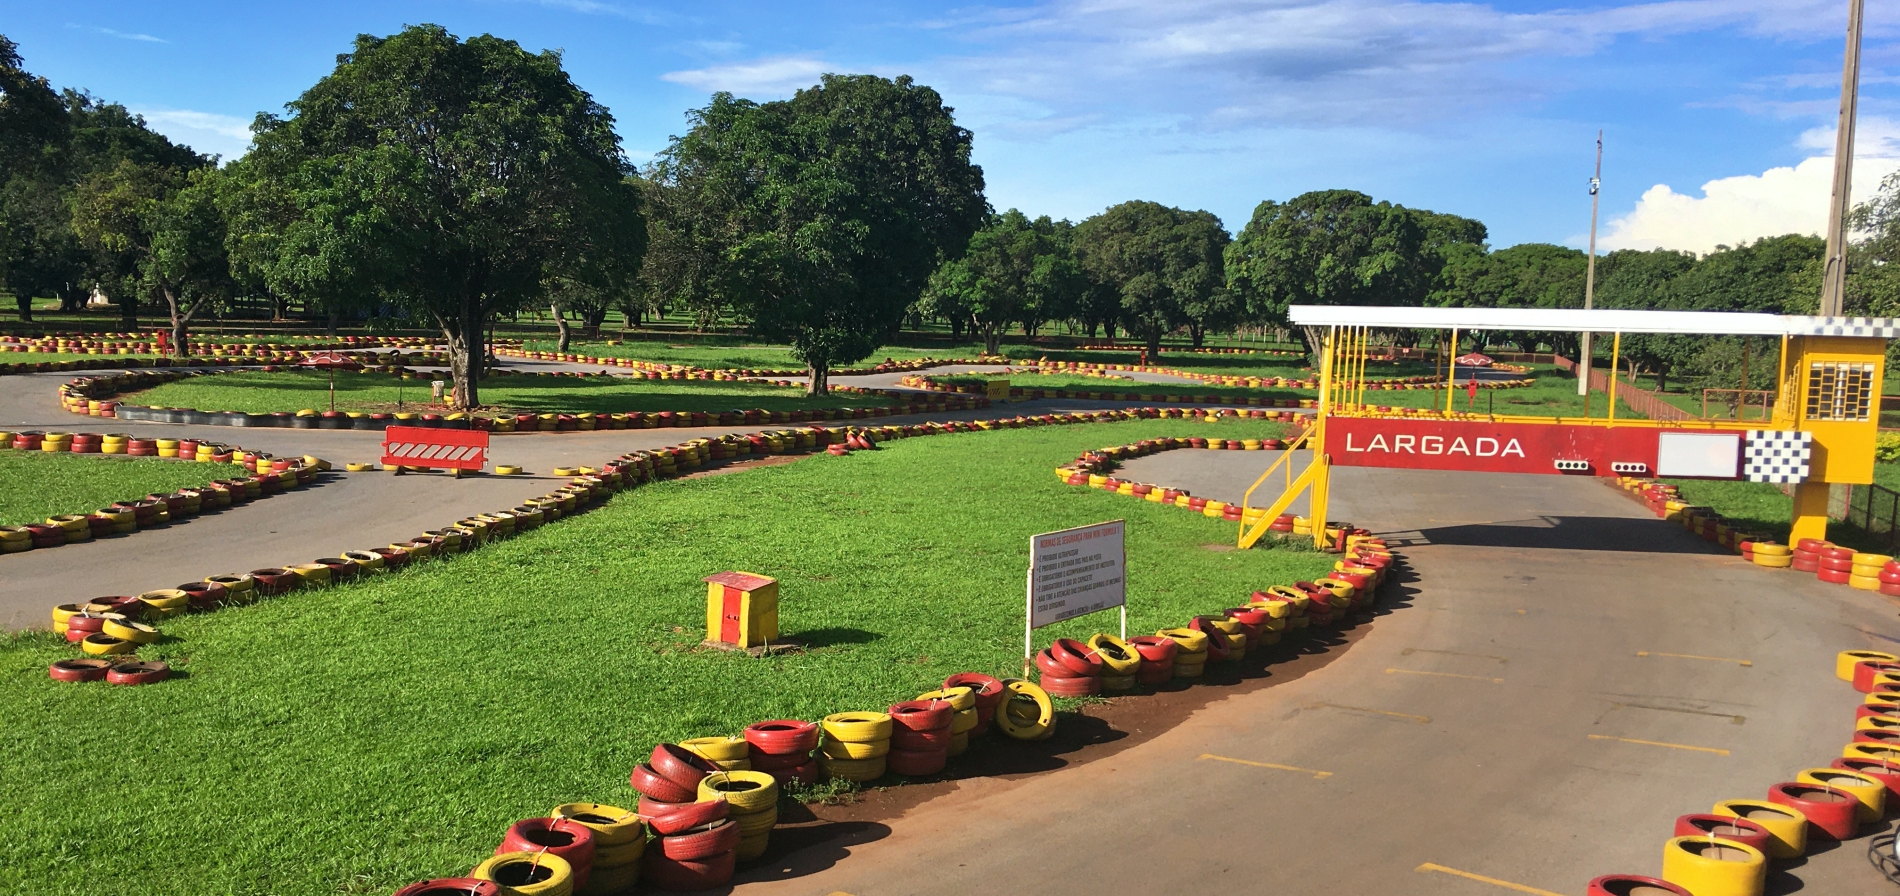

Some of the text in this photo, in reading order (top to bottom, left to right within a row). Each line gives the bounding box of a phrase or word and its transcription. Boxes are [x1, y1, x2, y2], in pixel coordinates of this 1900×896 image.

[1346, 433, 1525, 457] LARGADA
[1040, 538, 1057, 549] NORMAS
[1057, 537, 1061, 546] DE
[1062, 533, 1082, 546] SEGURANÇA
[1083, 531, 1092, 541] PARA
[1093, 530, 1101, 539] MINI
